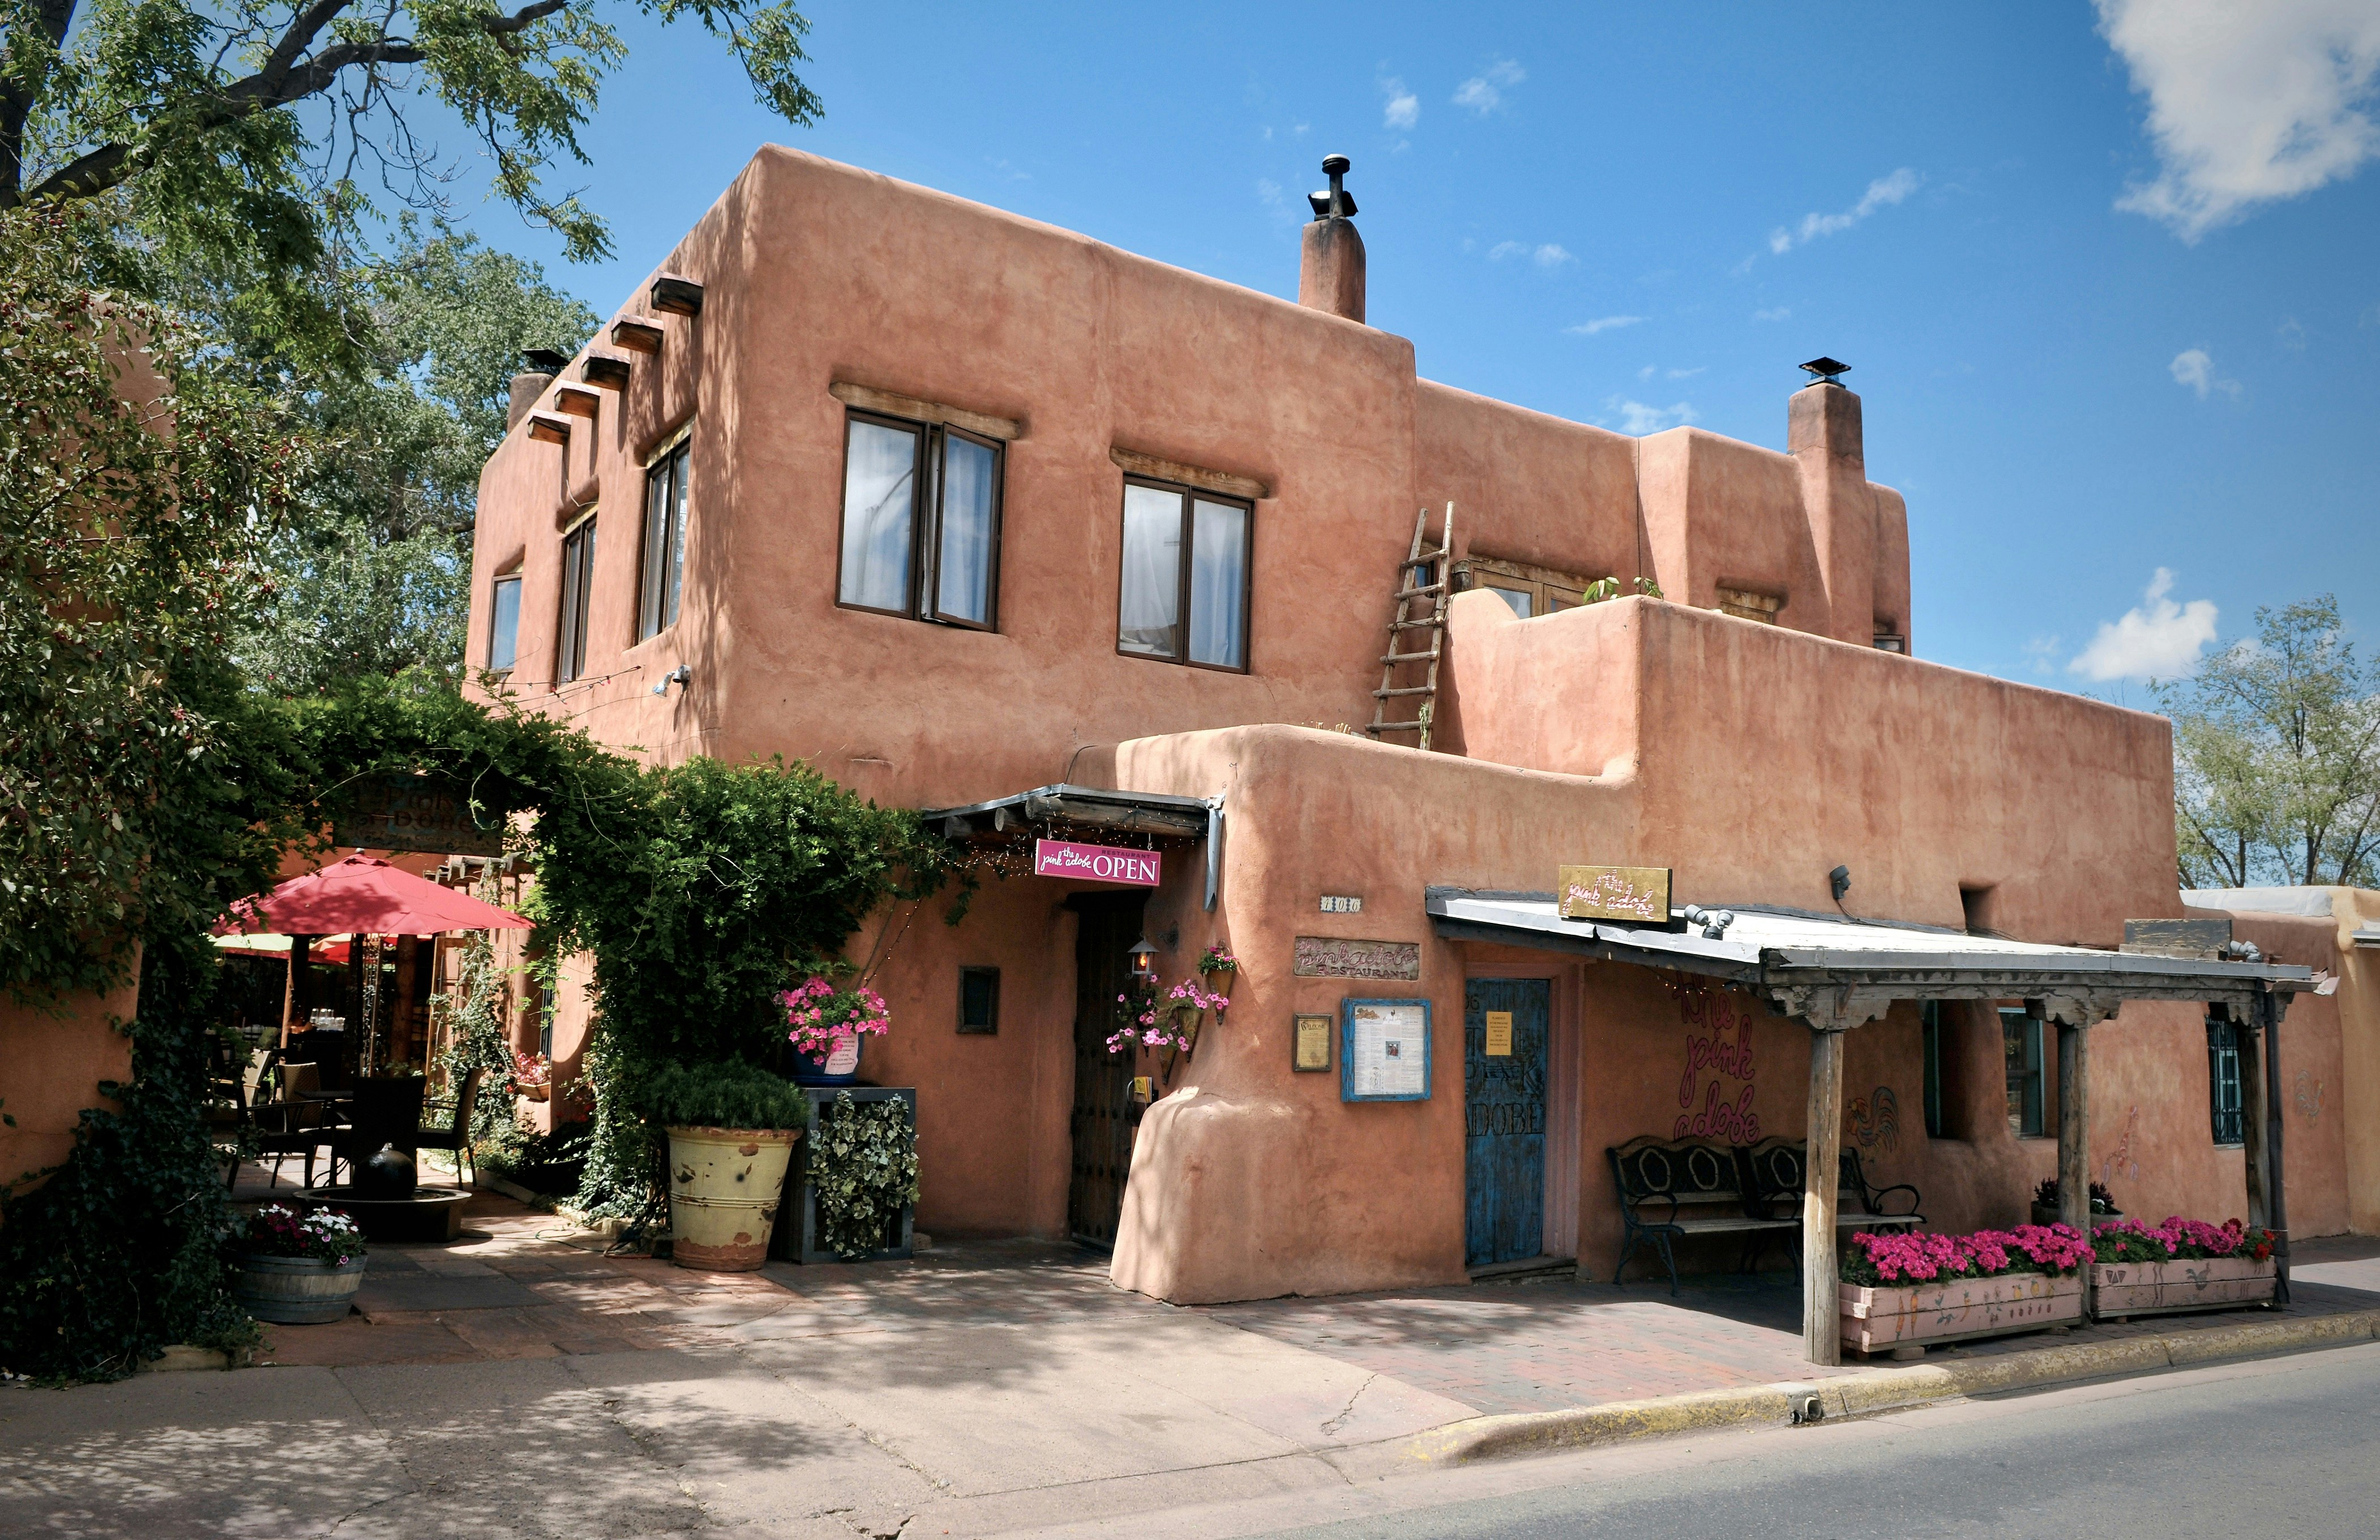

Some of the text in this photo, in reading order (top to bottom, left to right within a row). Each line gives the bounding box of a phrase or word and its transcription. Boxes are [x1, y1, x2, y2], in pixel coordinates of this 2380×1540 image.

[1040, 850, 1091, 871] pink adobe
[1062, 846, 1075, 858] the
[1102, 849, 1151, 859] RESTAURANT
[1093, 855, 1157, 882] OPEN
[1602, 869, 1624, 893] the
[1324, 897, 1358, 911] 106
[1297, 942, 1418, 970] pink adobe
[1680, 1014, 1755, 1108] pink
[1673, 1080, 1760, 1144] adobe
